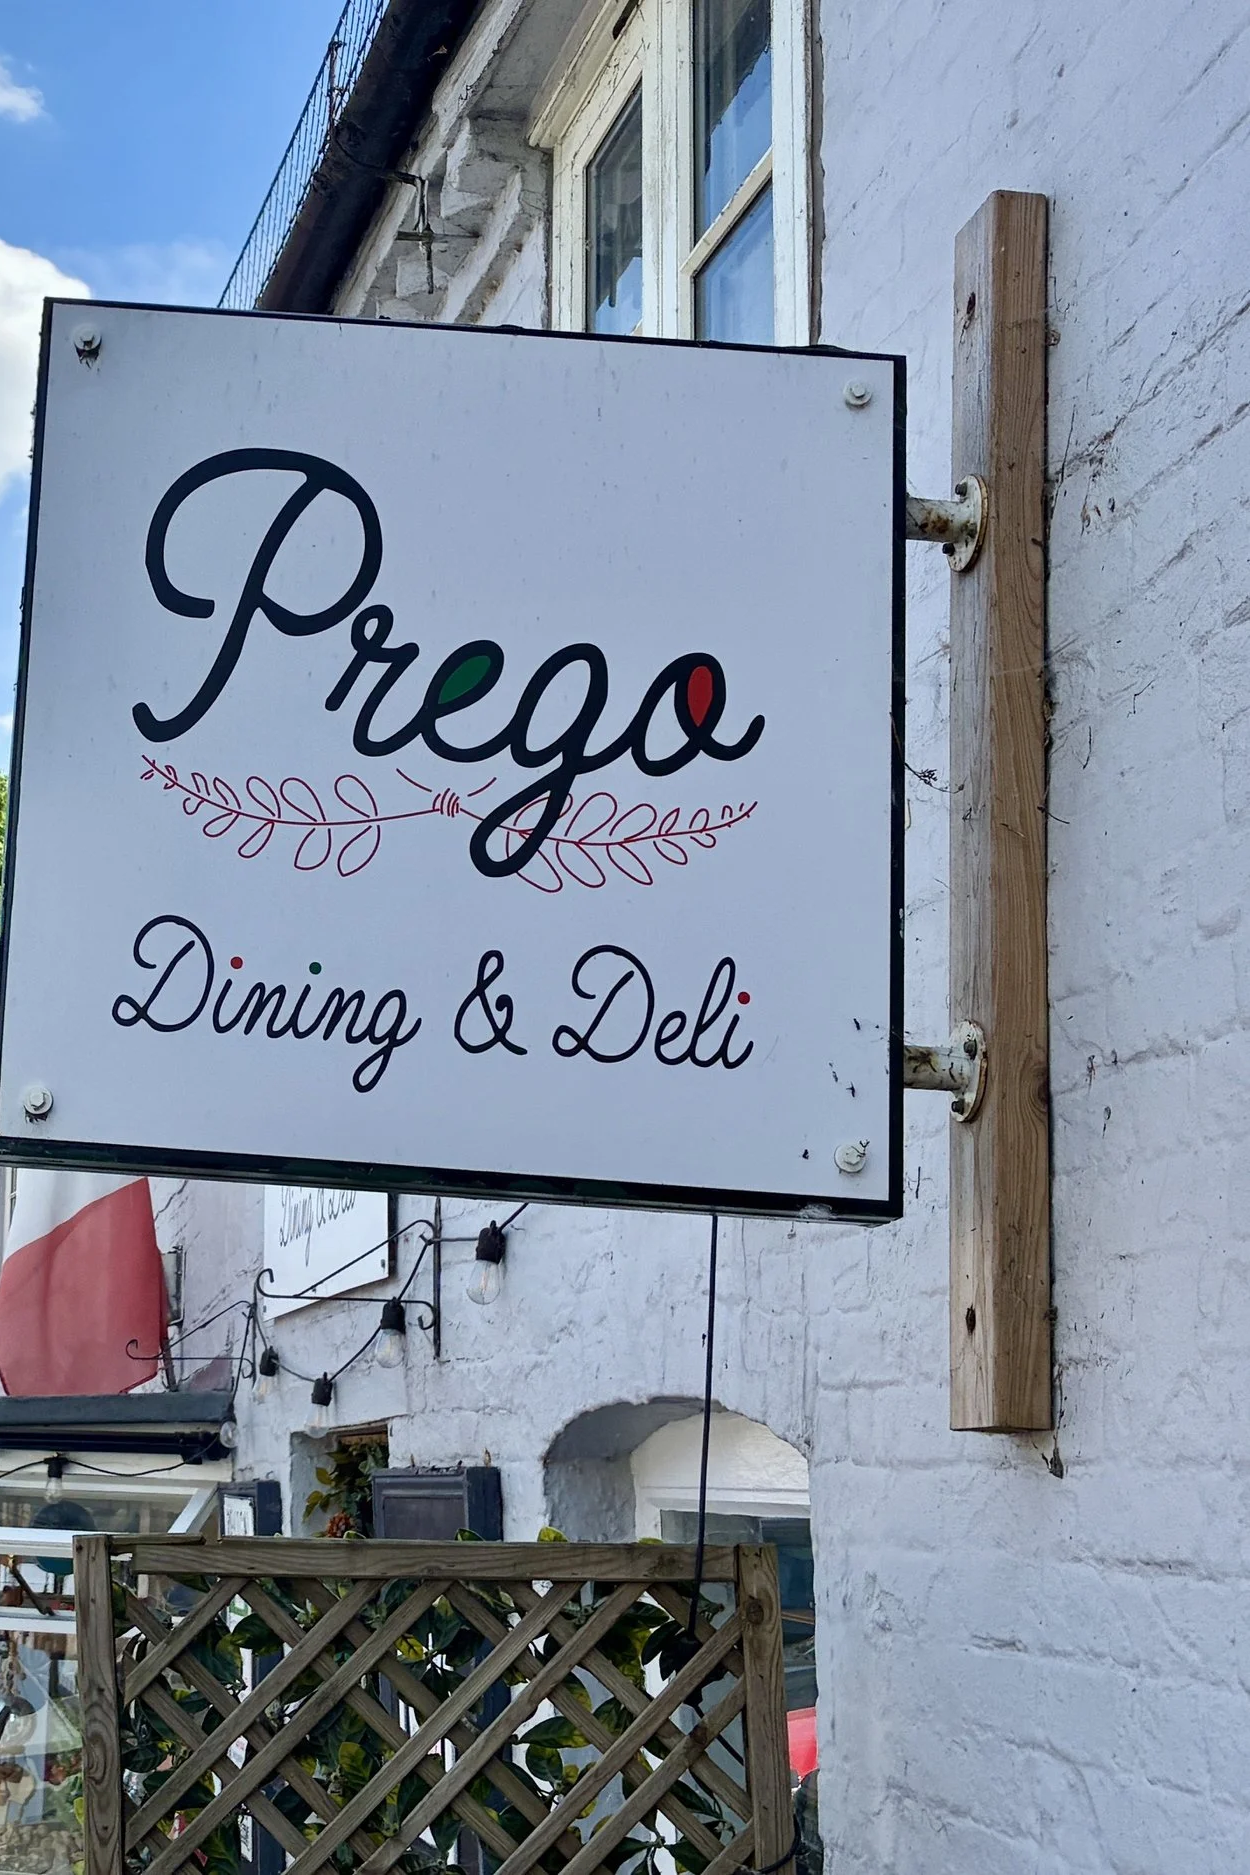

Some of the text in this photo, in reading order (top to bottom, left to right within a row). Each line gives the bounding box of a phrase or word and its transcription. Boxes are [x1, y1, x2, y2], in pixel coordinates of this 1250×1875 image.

[132, 448, 765, 878] Prego
[112, 915, 754, 1094] Dining & Deli
